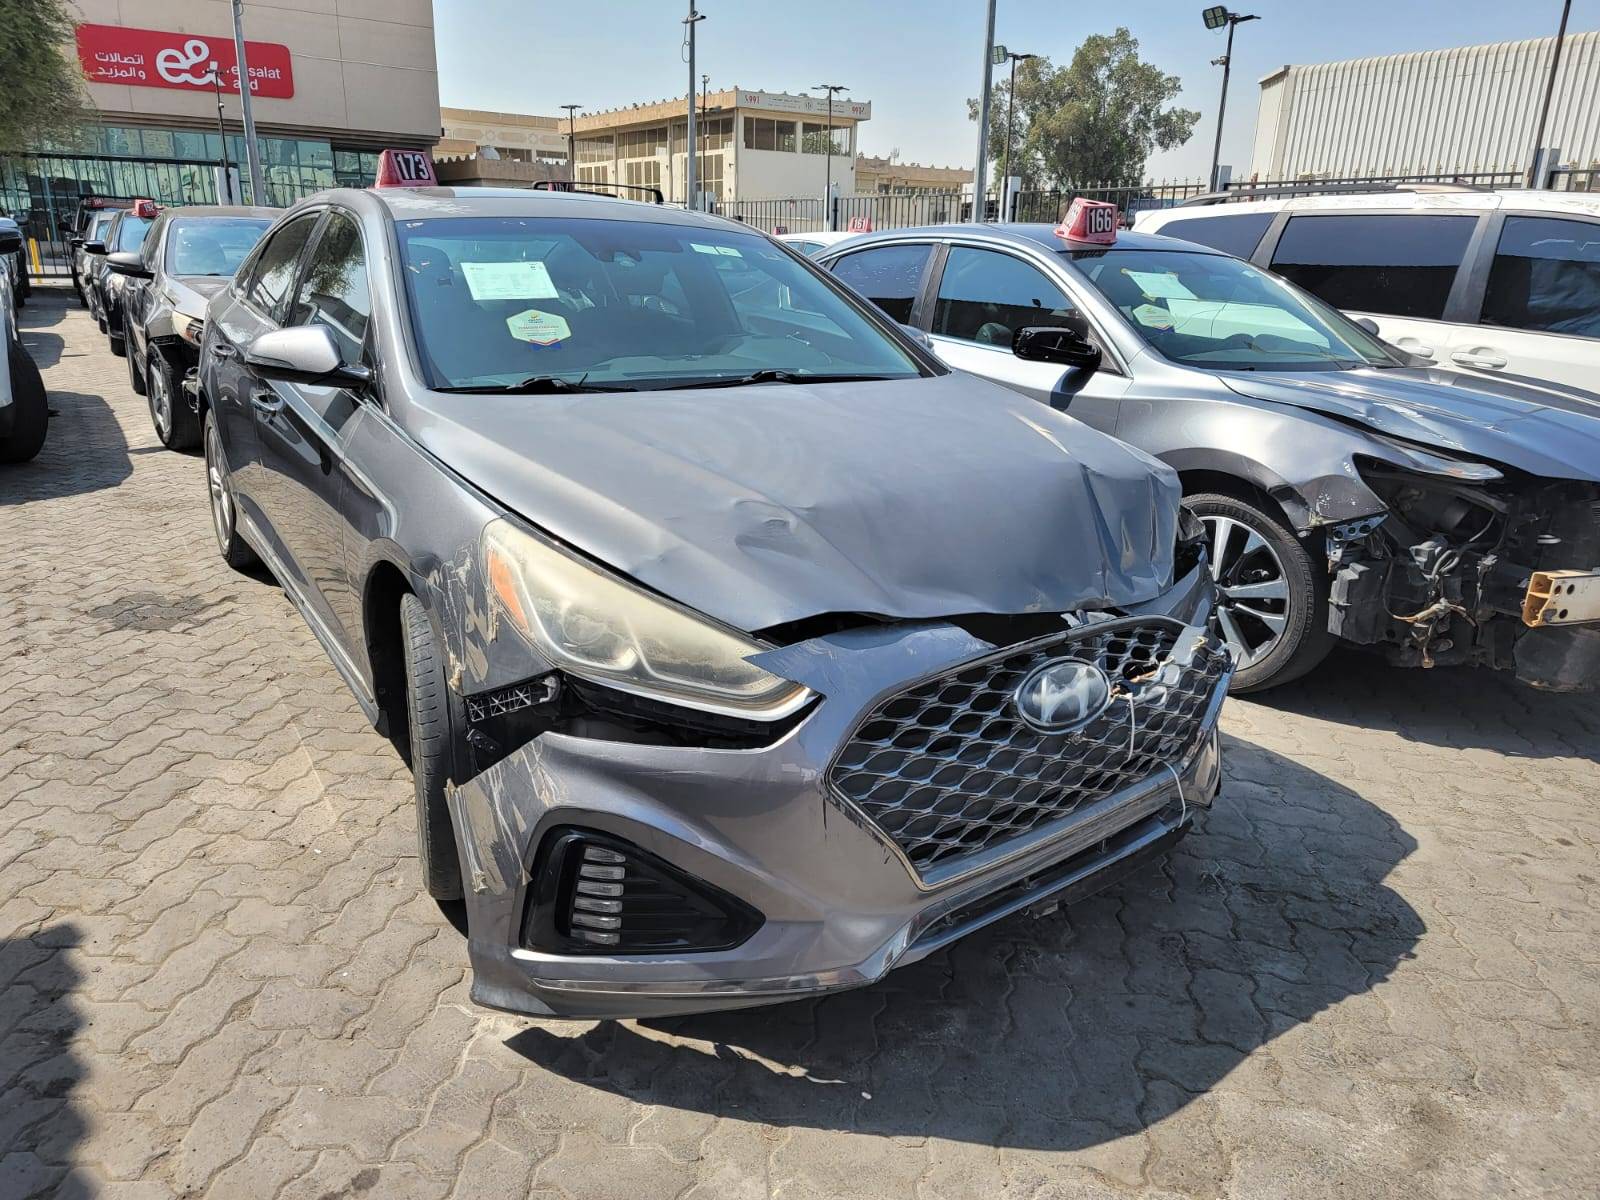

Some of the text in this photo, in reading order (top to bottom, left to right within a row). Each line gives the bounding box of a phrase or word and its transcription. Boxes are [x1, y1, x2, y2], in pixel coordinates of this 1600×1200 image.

[95, 51, 145, 65] اتصالات
[230, 65, 281, 80] esalat
[233, 78, 258, 90] ad
[396, 153, 430, 180] 173
[1090, 208, 1112, 233] 166
